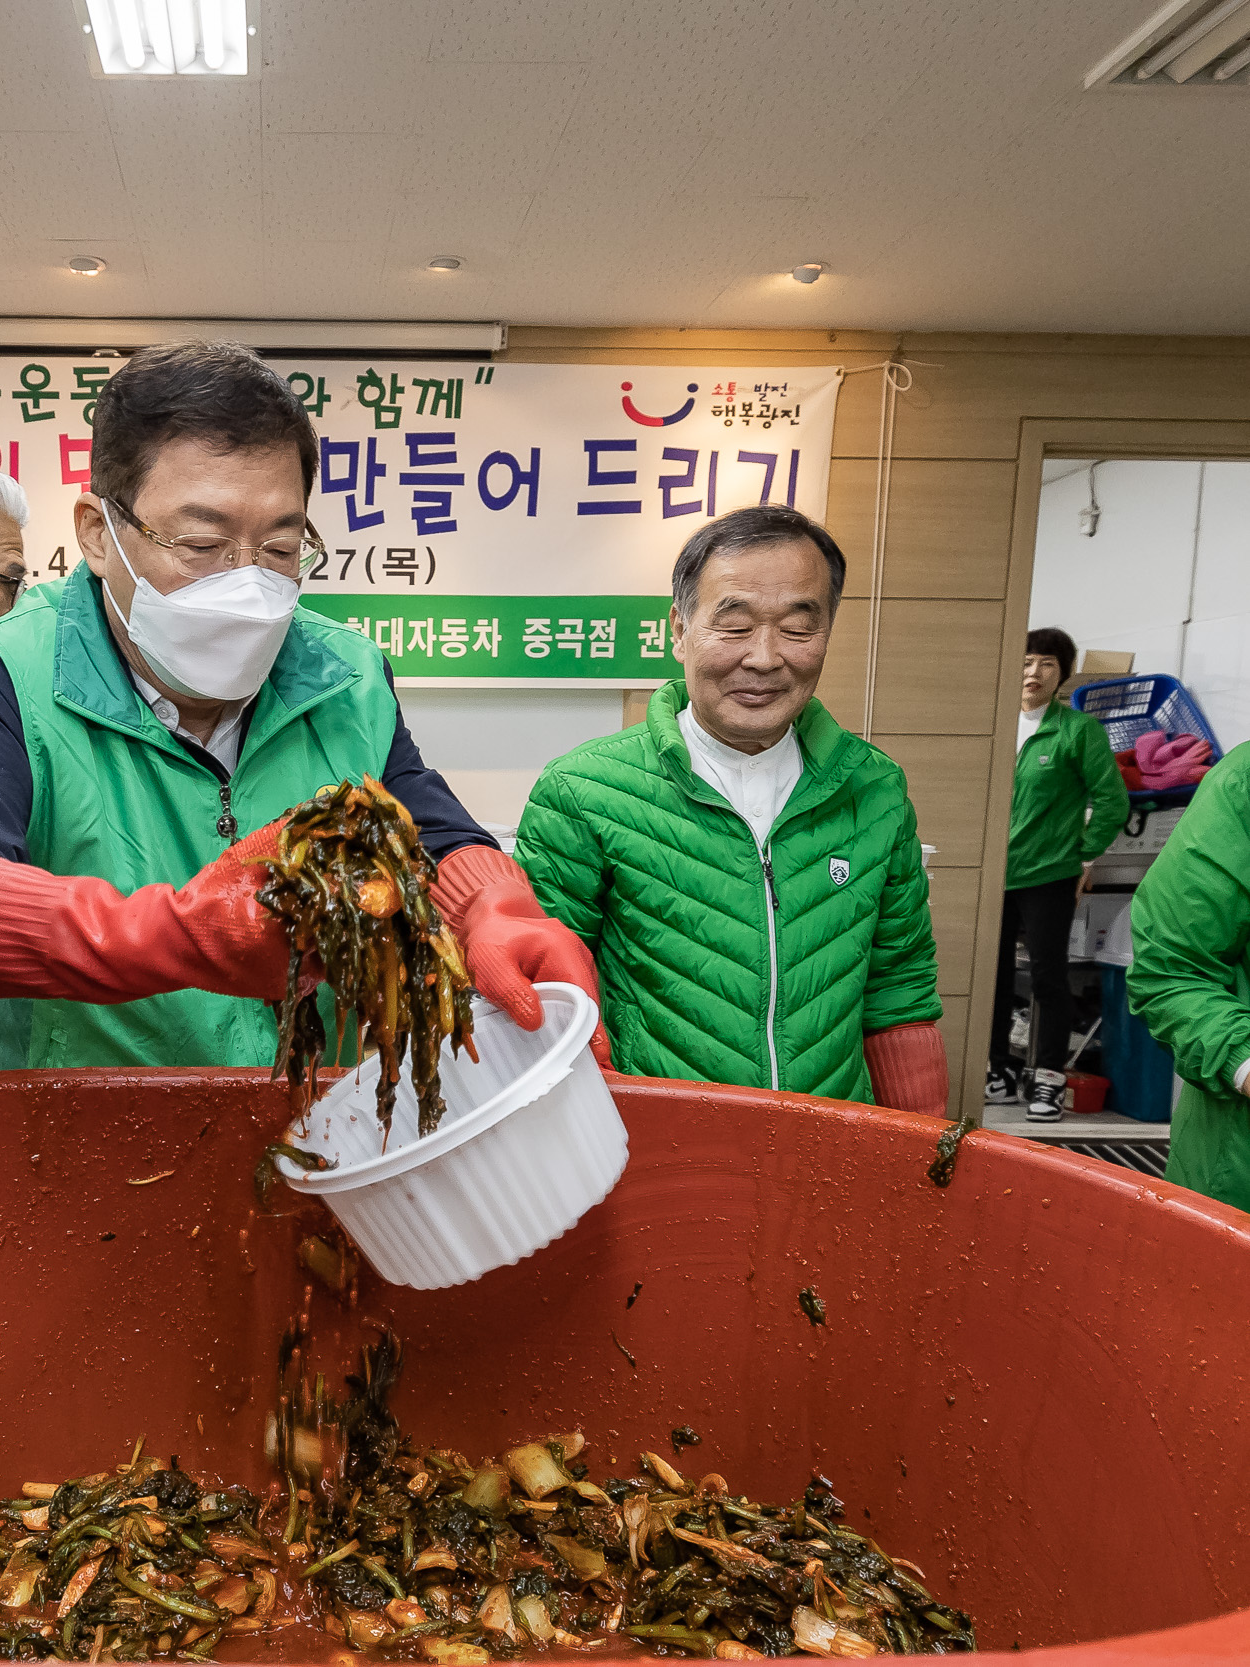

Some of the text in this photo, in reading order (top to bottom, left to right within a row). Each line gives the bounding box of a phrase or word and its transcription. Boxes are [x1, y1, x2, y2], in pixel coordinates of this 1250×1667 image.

[711, 382, 788, 403] 소통 발전
[711, 402, 801, 429] 행복광진
[320, 431, 540, 536] 만들어
[577, 438, 801, 519] 드리기
[522, 618, 617, 658] 중곡점
[638, 618, 673, 658] 권
